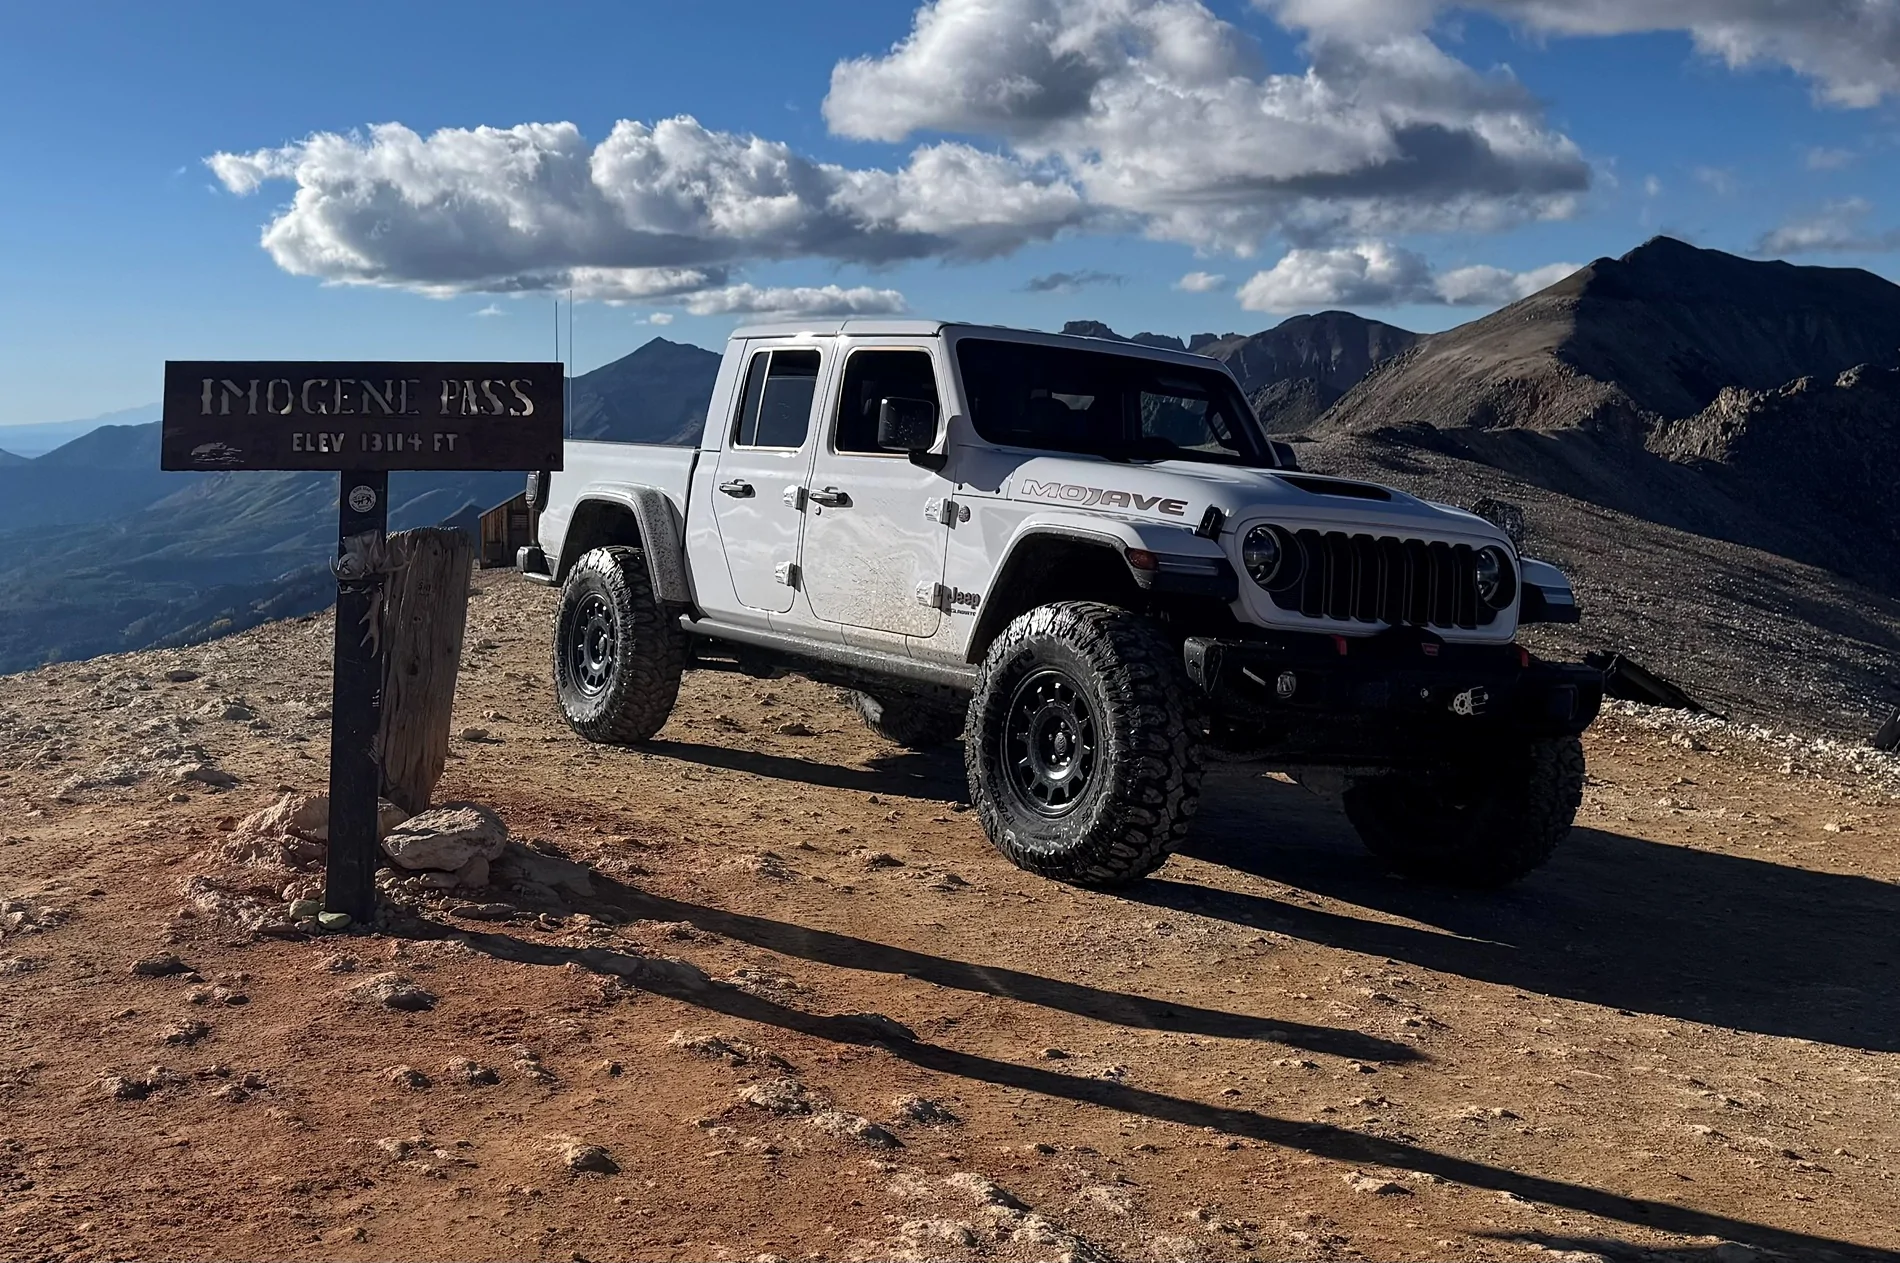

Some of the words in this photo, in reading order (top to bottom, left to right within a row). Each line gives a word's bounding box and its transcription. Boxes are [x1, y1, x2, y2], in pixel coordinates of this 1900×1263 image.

[200, 378, 420, 415] IMOGENE
[439, 379, 534, 416] PASS
[292, 432, 345, 453] ELEV
[361, 432, 423, 451] 13114
[433, 433, 459, 451] FT
[1021, 479, 1188, 516] MOJAVE
[948, 586, 982, 610] Jeep
